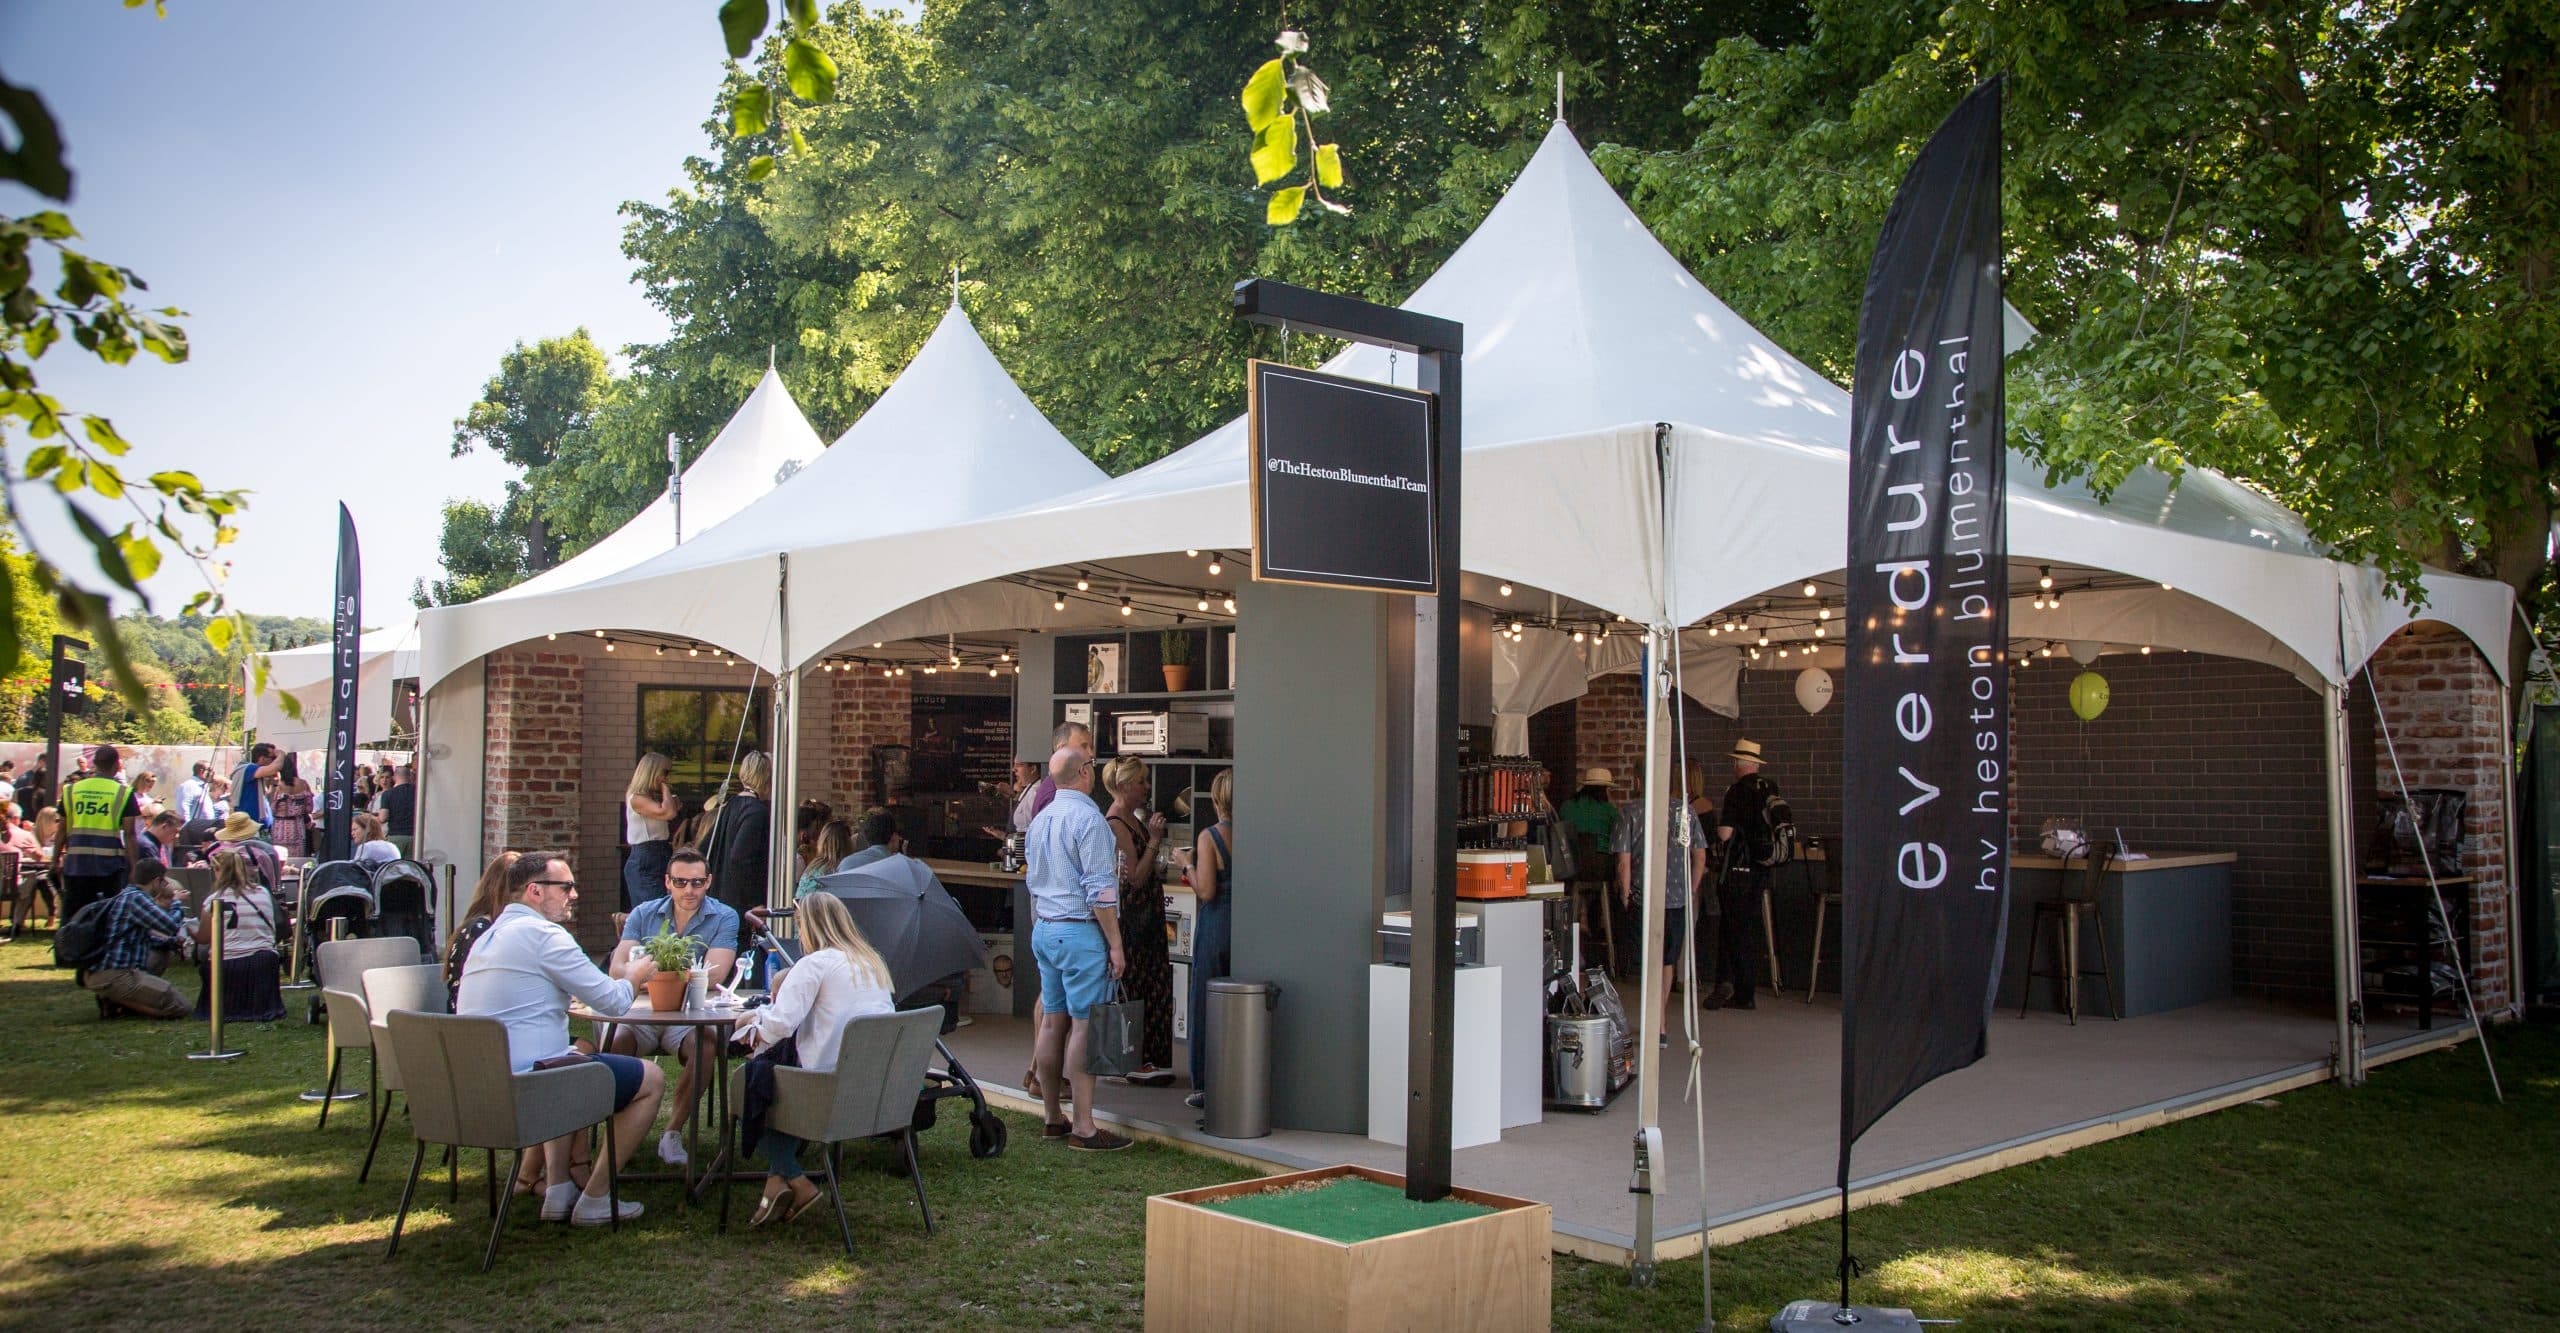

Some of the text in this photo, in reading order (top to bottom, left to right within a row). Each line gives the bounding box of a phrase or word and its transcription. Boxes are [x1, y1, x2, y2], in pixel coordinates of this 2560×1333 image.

[1268, 458, 1427, 493] @TheHestonBlumenthalTeam
[1939, 336, 1988, 620] blumenthal
[1876, 349, 1947, 889] everdure
[75, 801, 110, 816] 054
[1968, 645, 2000, 812] heston
